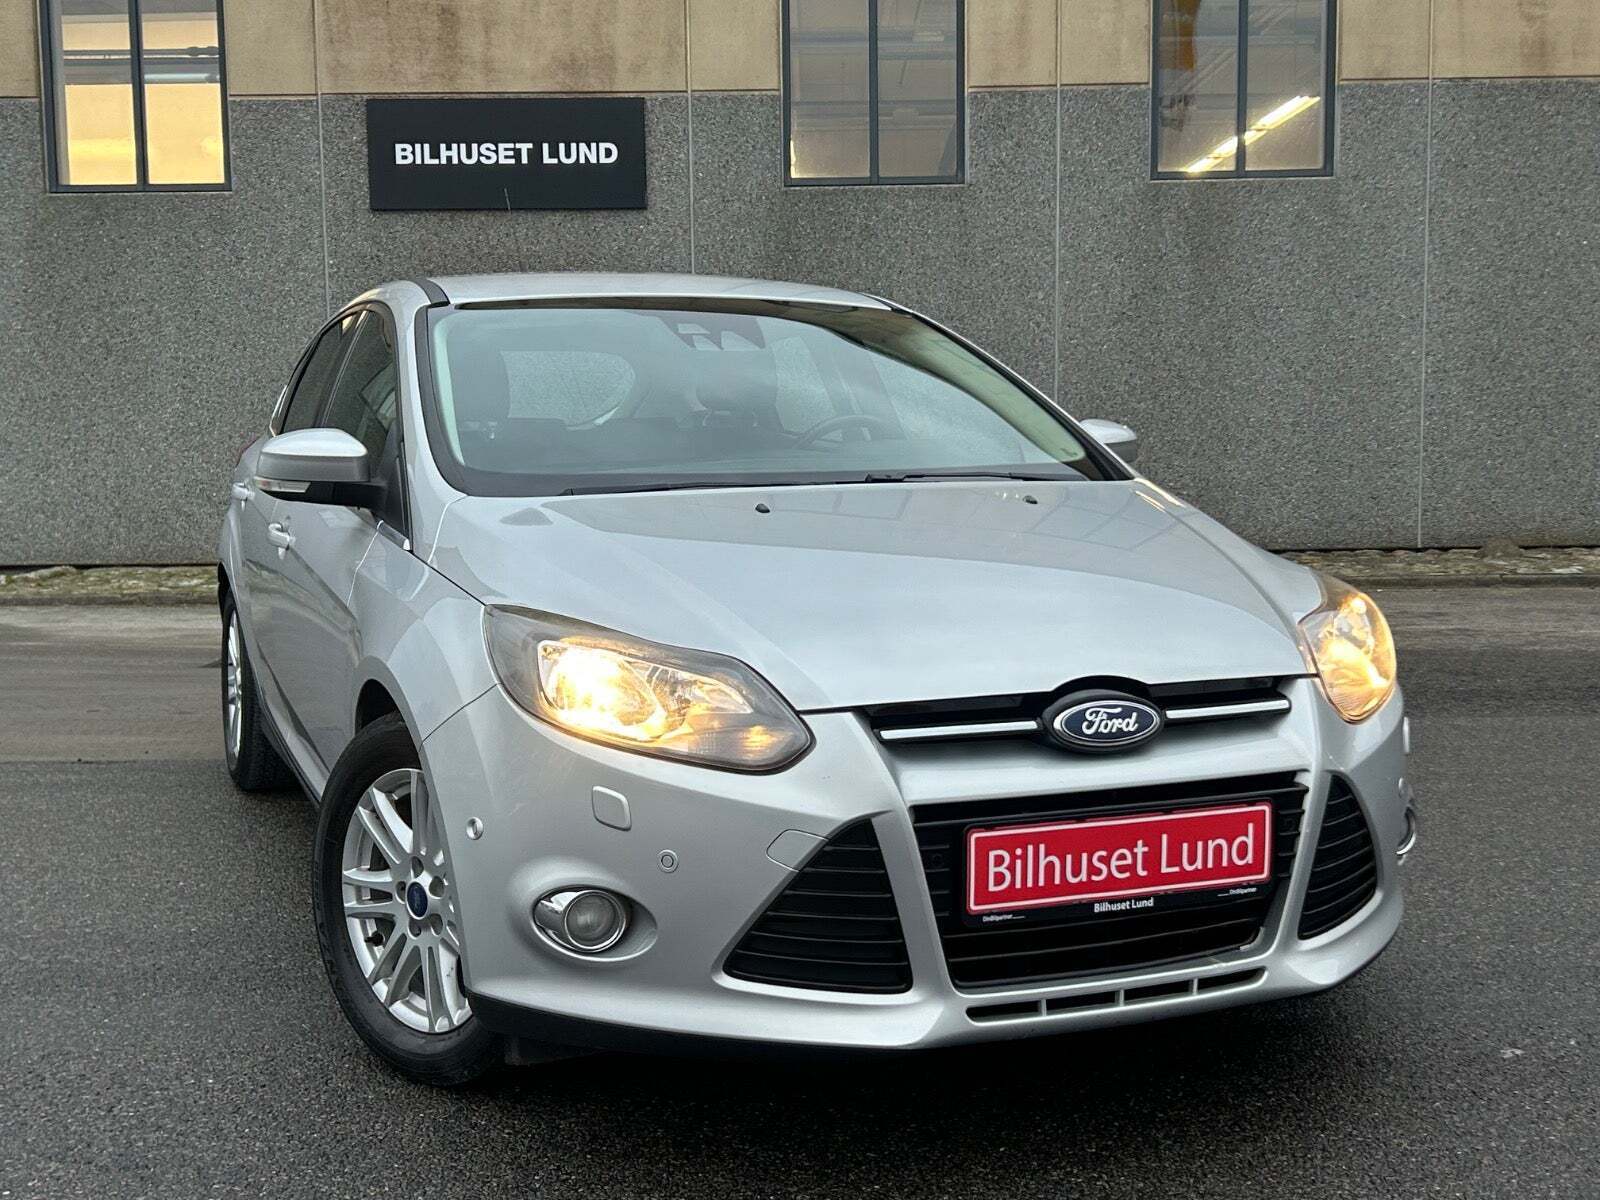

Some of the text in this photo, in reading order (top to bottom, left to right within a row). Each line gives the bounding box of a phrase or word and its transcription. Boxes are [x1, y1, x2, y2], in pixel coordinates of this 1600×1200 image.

[394, 142, 619, 165] BILHUSET LUND
[1082, 707, 1138, 734] Ford
[987, 822, 1254, 892] Bilhuset Lund
[1093, 896, 1154, 912] Bilhuset Lund
